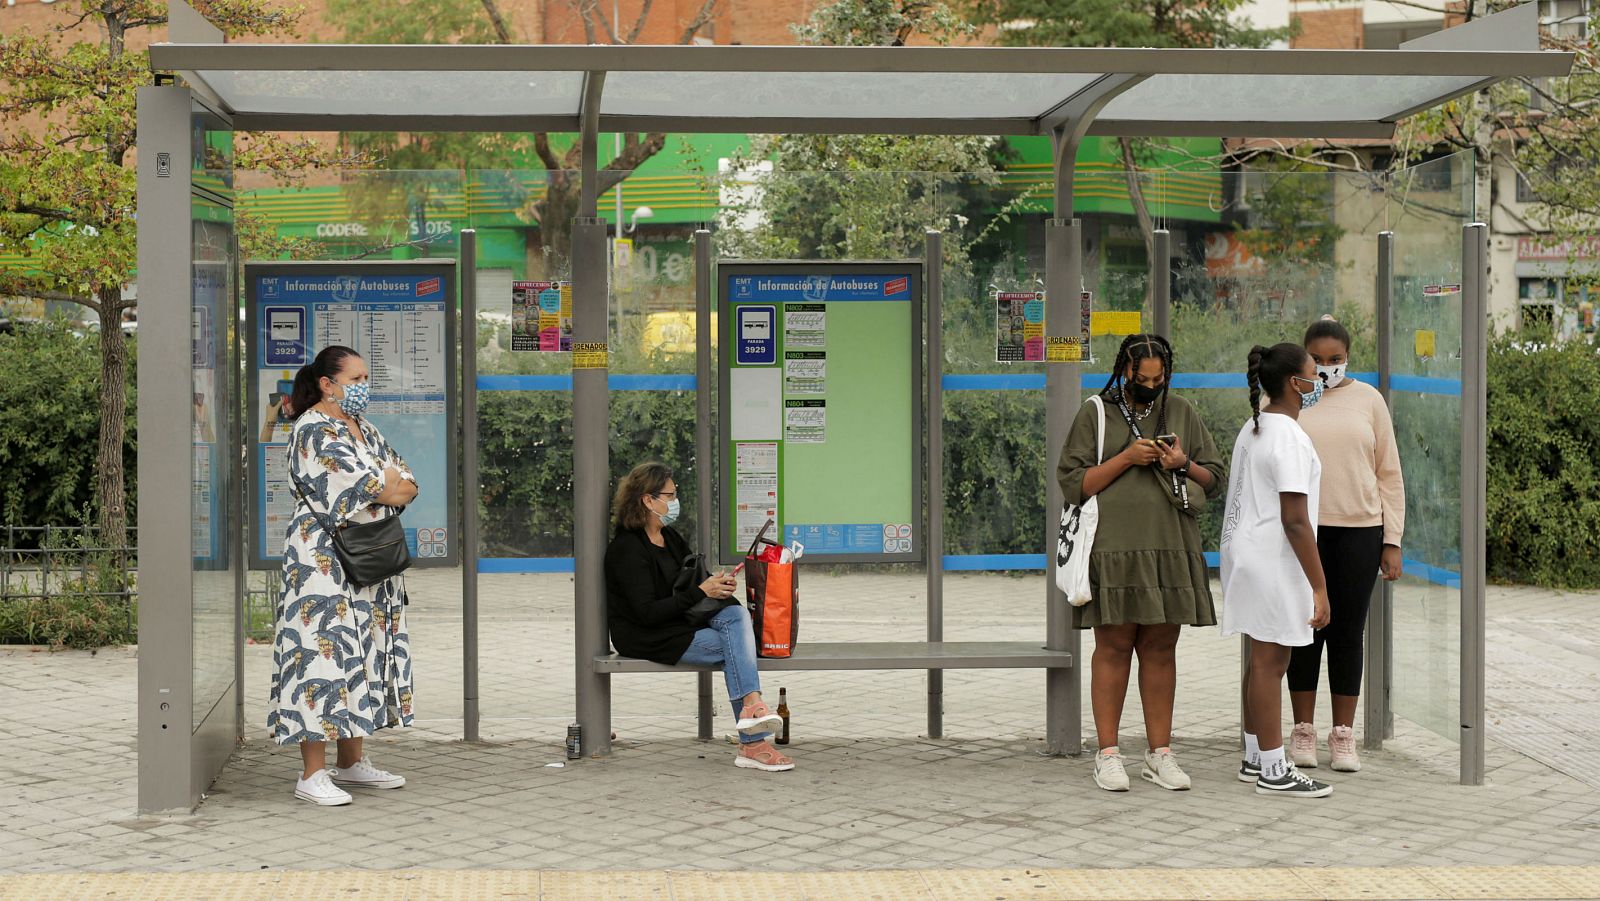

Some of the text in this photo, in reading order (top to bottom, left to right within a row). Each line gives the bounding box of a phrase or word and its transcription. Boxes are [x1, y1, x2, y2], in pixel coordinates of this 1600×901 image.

[410, 220, 452, 235] SOTS
[262, 277, 278, 285] EMT
[285, 279, 342, 292] Información
[345, 279, 358, 291] de
[360, 279, 410, 291] Autobuses
[758, 279, 813, 291] Información
[816, 279, 827, 291] de
[830, 279, 878, 291] Autobuses
[275, 347, 297, 355] 3929
[745, 346, 766, 354] 3929
